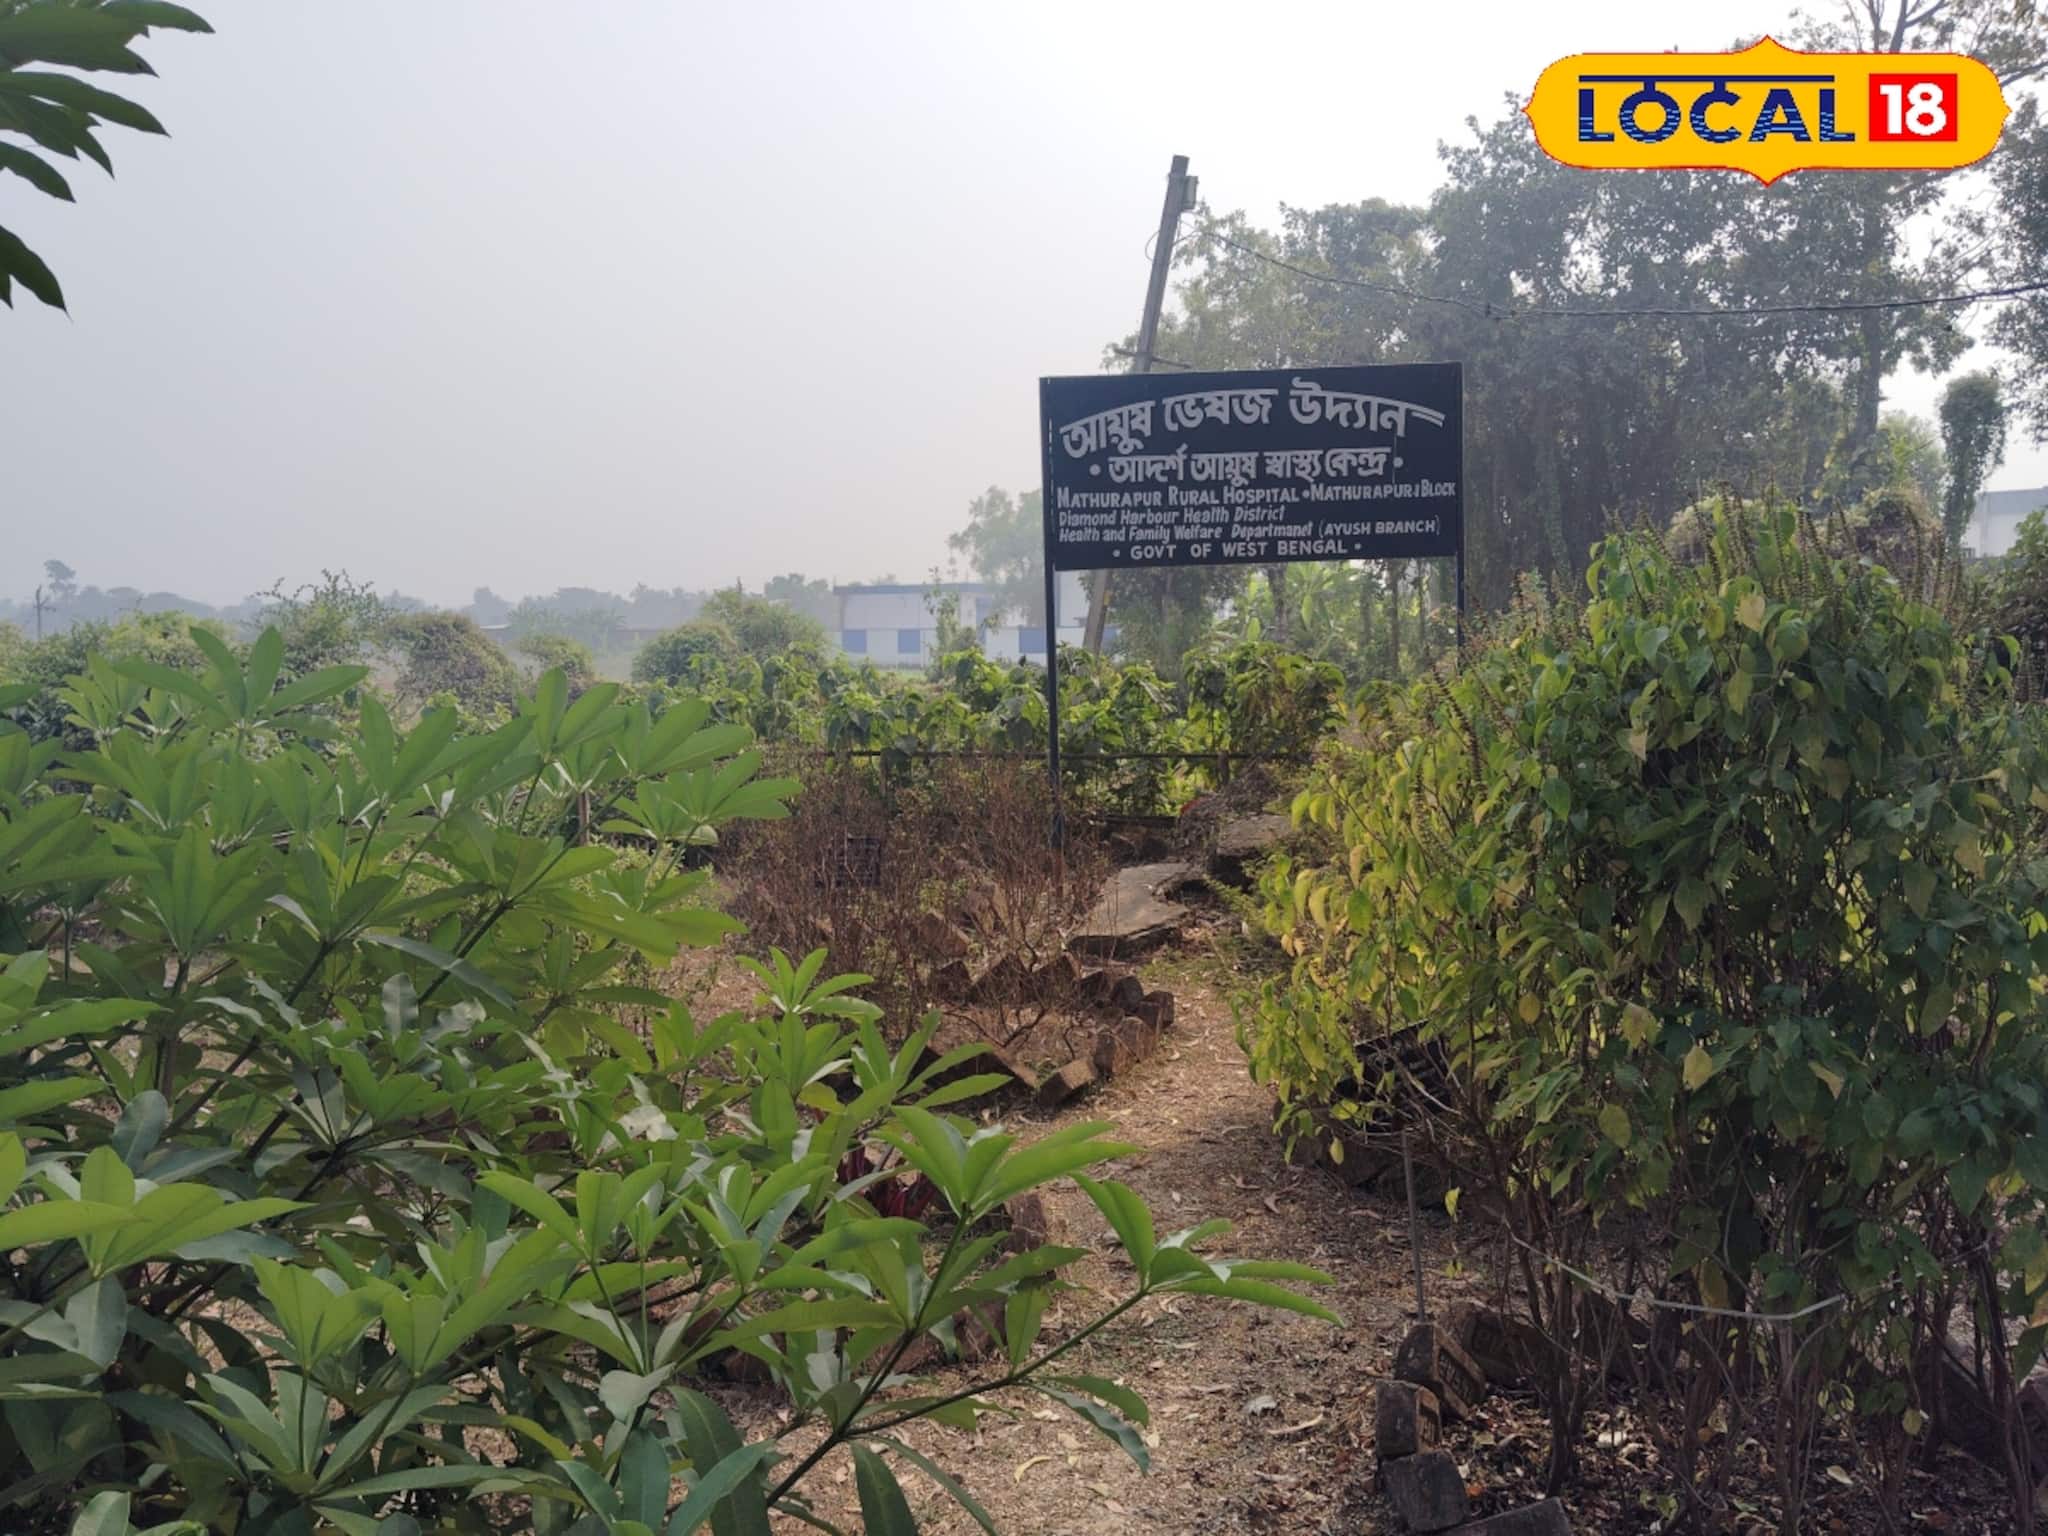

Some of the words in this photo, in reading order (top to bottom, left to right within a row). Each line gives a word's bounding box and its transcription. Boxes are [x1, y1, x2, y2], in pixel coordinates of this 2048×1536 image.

[1162, 388, 1279, 432] ভেষজ
[1288, 377, 1446, 437] উদ্যান
[1325, 447, 1392, 477] কেন্দ্র
[1057, 487, 1162, 509] MATHURAPUR
[1168, 486, 1220, 506] RURAL
[1223, 485, 1300, 505] HOSPITAL
[1421, 479, 1457, 498] BLOCK
[1059, 510, 1117, 527] Diamond
[1120, 508, 1180, 525] Harbour
[1184, 506, 1229, 524] Health
[1233, 504, 1285, 522] District
[1059, 527, 1100, 543] Health
[1102, 525, 1126, 542] and
[1129, 524, 1171, 544] Family
[1174, 524, 1223, 541] Welfare
[1130, 544, 1177, 560] GOVT
[1190, 543, 1212, 558] OF
[1222, 541, 1268, 558] WEST
[1277, 539, 1348, 556] BENGAL
